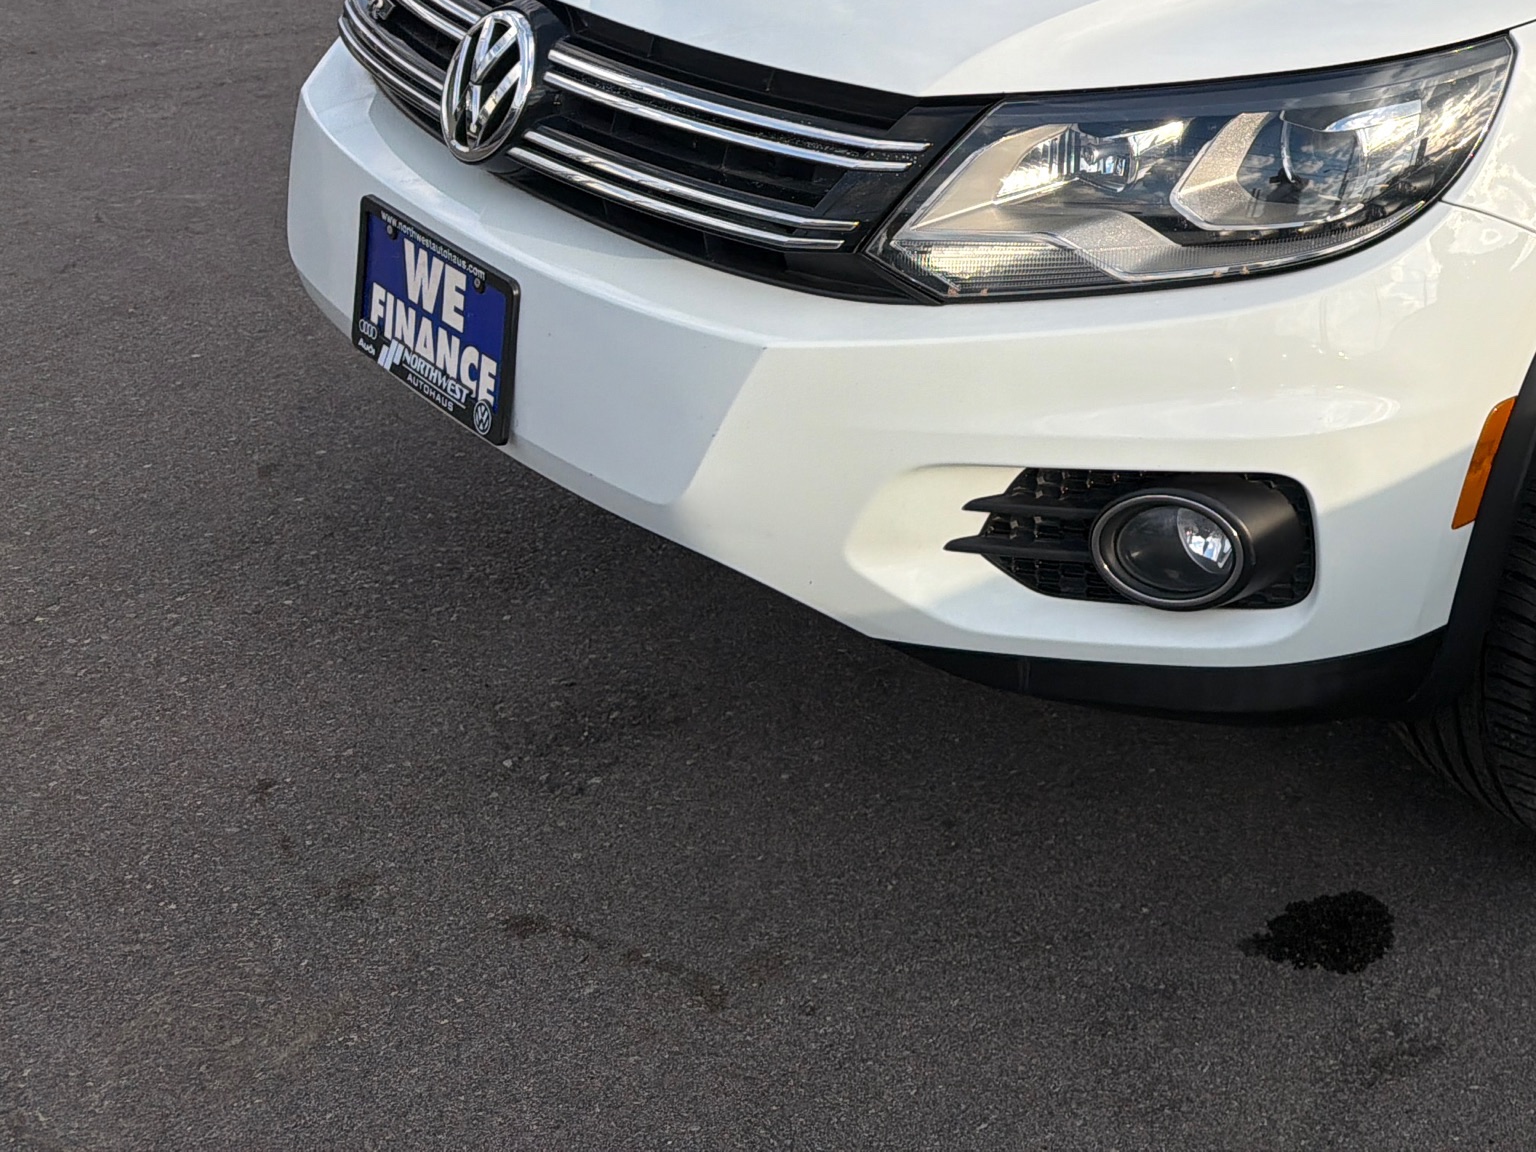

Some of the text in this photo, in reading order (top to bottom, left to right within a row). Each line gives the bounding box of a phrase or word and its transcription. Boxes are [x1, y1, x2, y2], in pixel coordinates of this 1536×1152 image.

[381, 210, 486, 279] www.northwestautohaus.com
[404, 238, 467, 333] WE
[358, 337, 376, 356] Audi
[370, 282, 498, 406] FINANCE
[403, 348, 469, 403] NORTHWEST
[407, 373, 454, 411] AUTOHAUS
